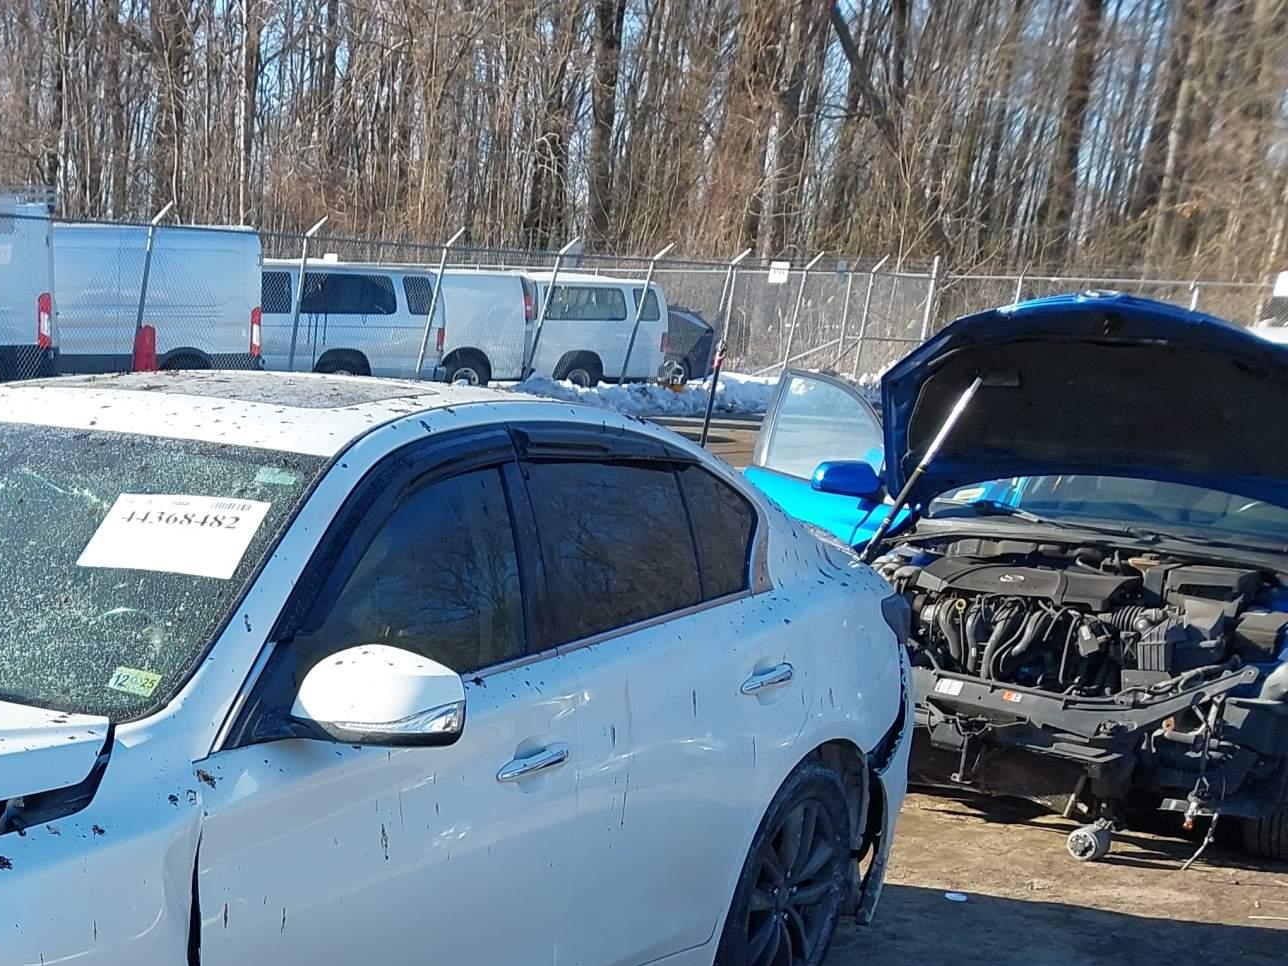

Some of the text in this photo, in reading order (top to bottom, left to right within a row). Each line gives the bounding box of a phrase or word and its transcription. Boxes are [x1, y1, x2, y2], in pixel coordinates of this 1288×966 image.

[122, 511, 241, 530] 44368482
[113, 672, 156, 689] 12 25
